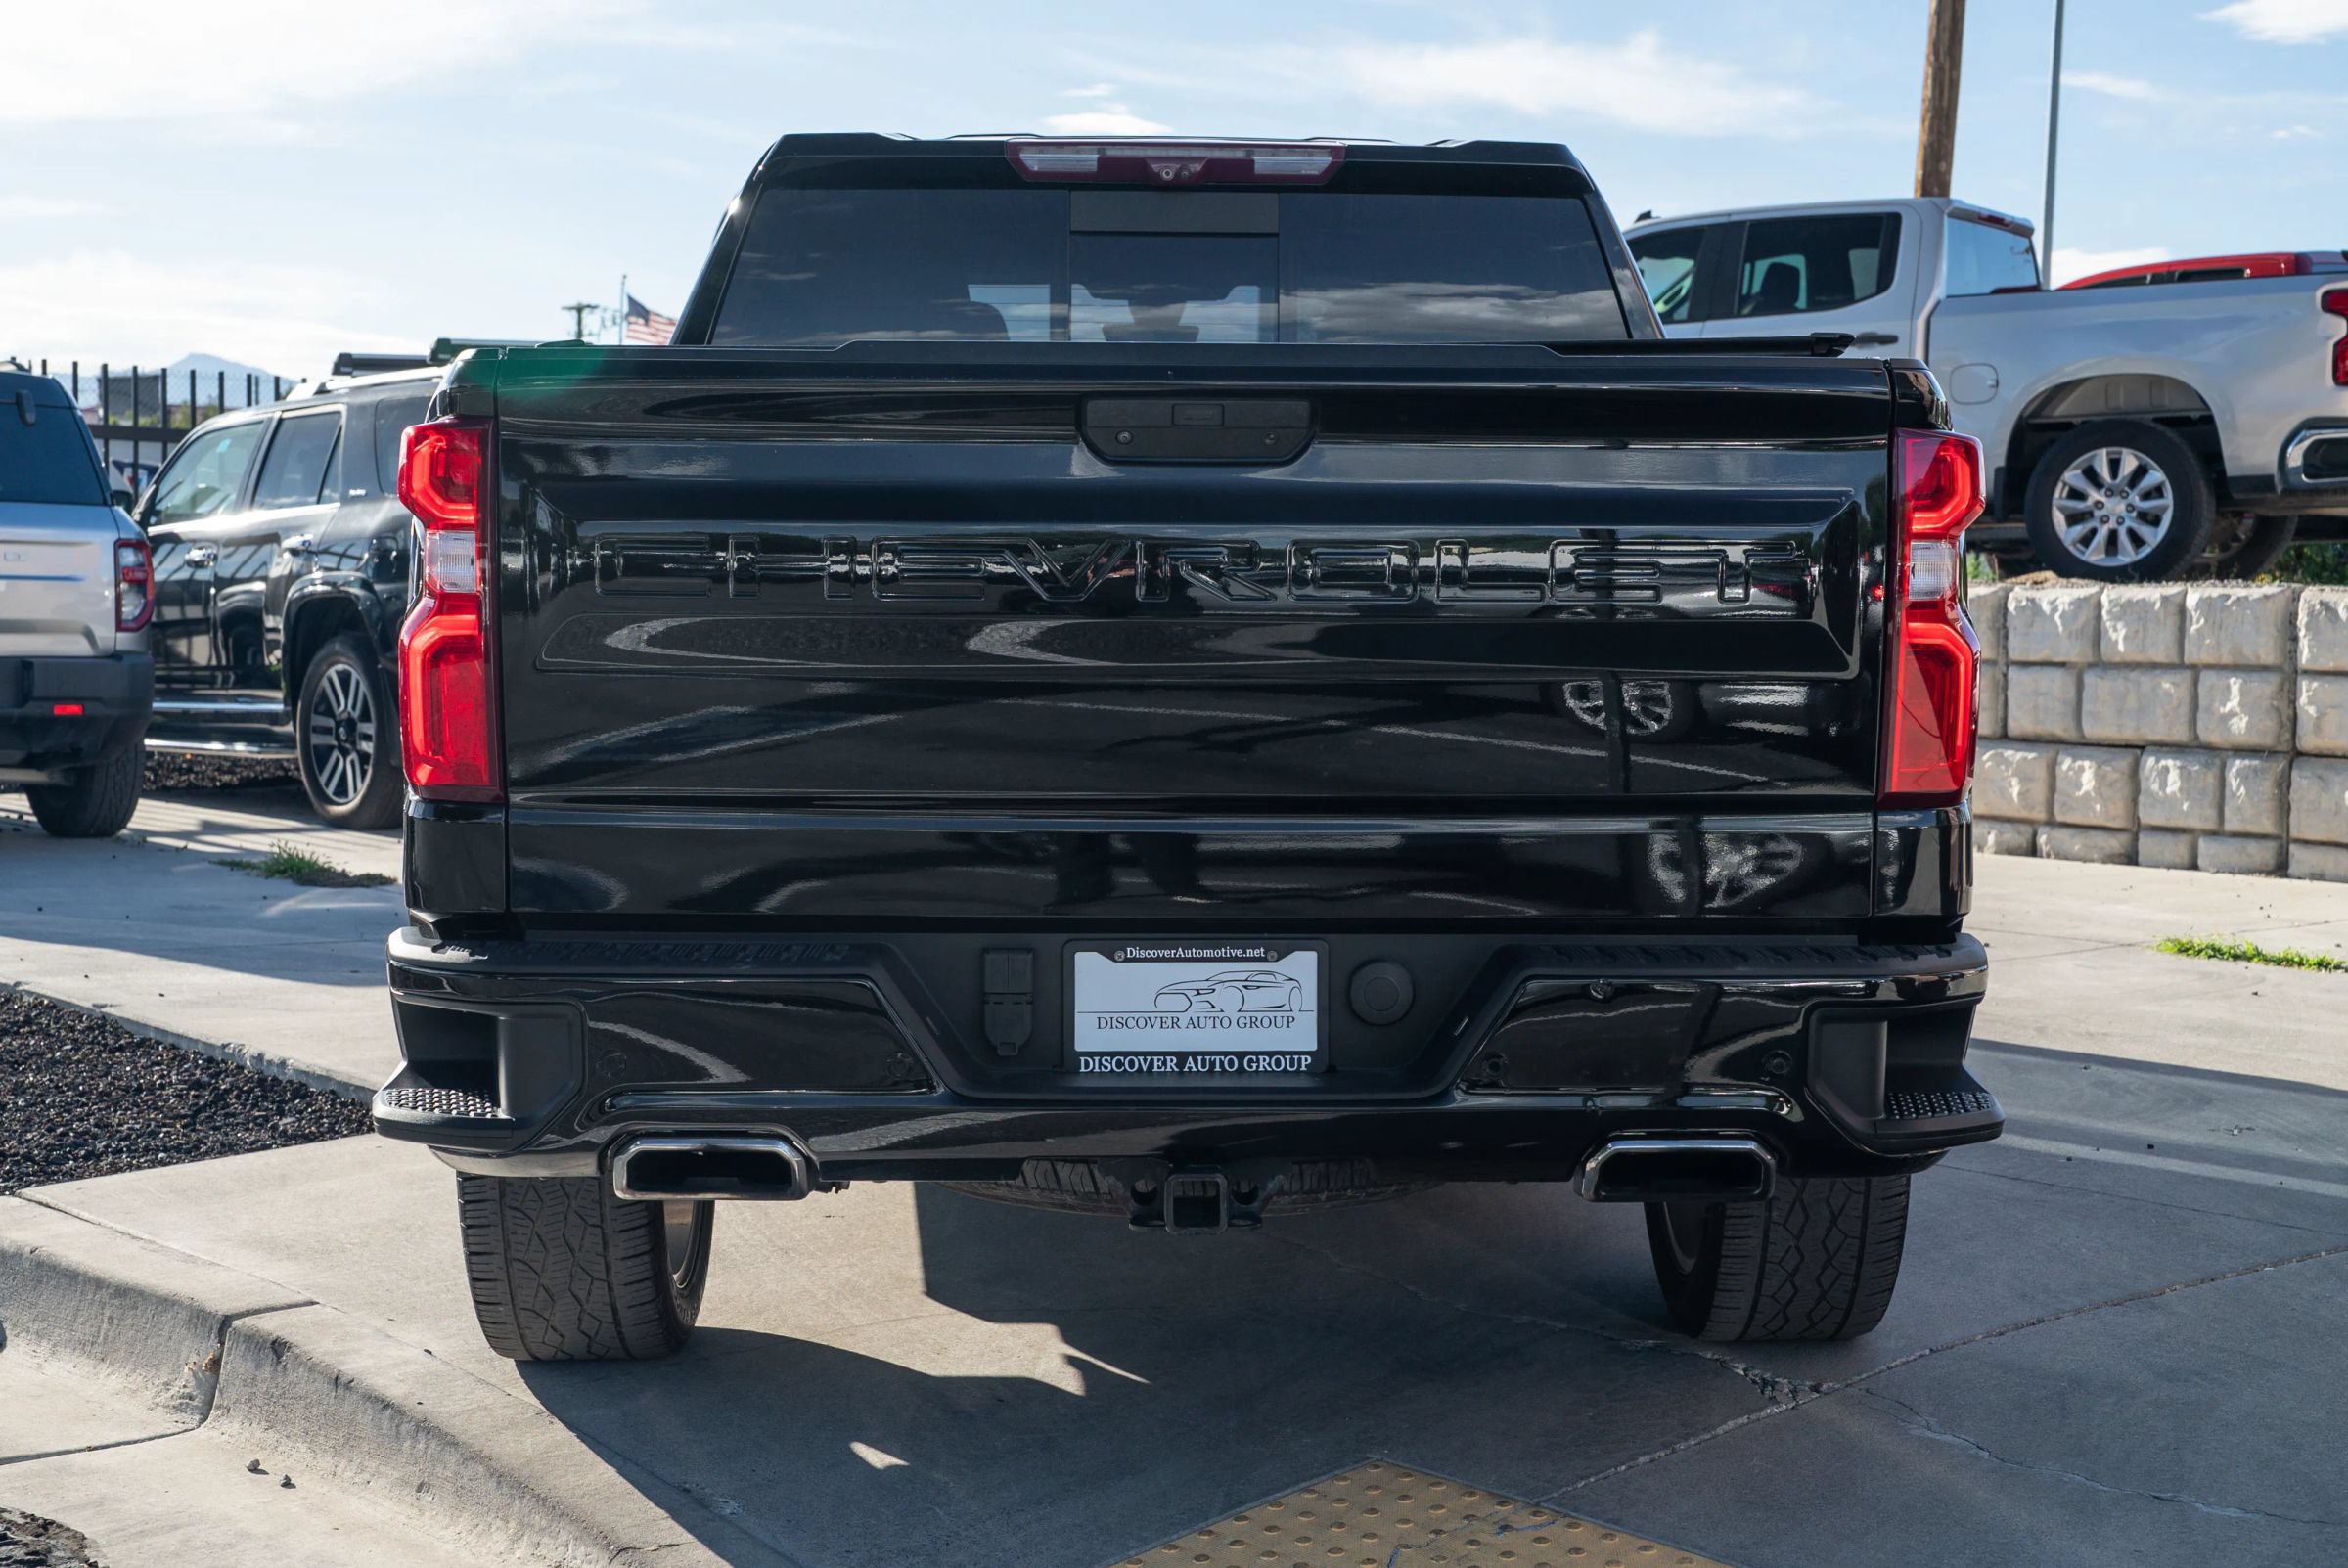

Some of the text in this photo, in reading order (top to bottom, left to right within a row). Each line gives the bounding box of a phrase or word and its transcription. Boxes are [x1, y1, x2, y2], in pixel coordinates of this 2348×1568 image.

[594, 533, 1797, 605] CHEVROLET
[1126, 947, 1266, 959] DiscoverAutomotive.net
[1096, 1015, 1295, 1030] DISCOVER AUTO GROUP
[1079, 1054, 1312, 1072] DISCOVER AUTO GROUP
